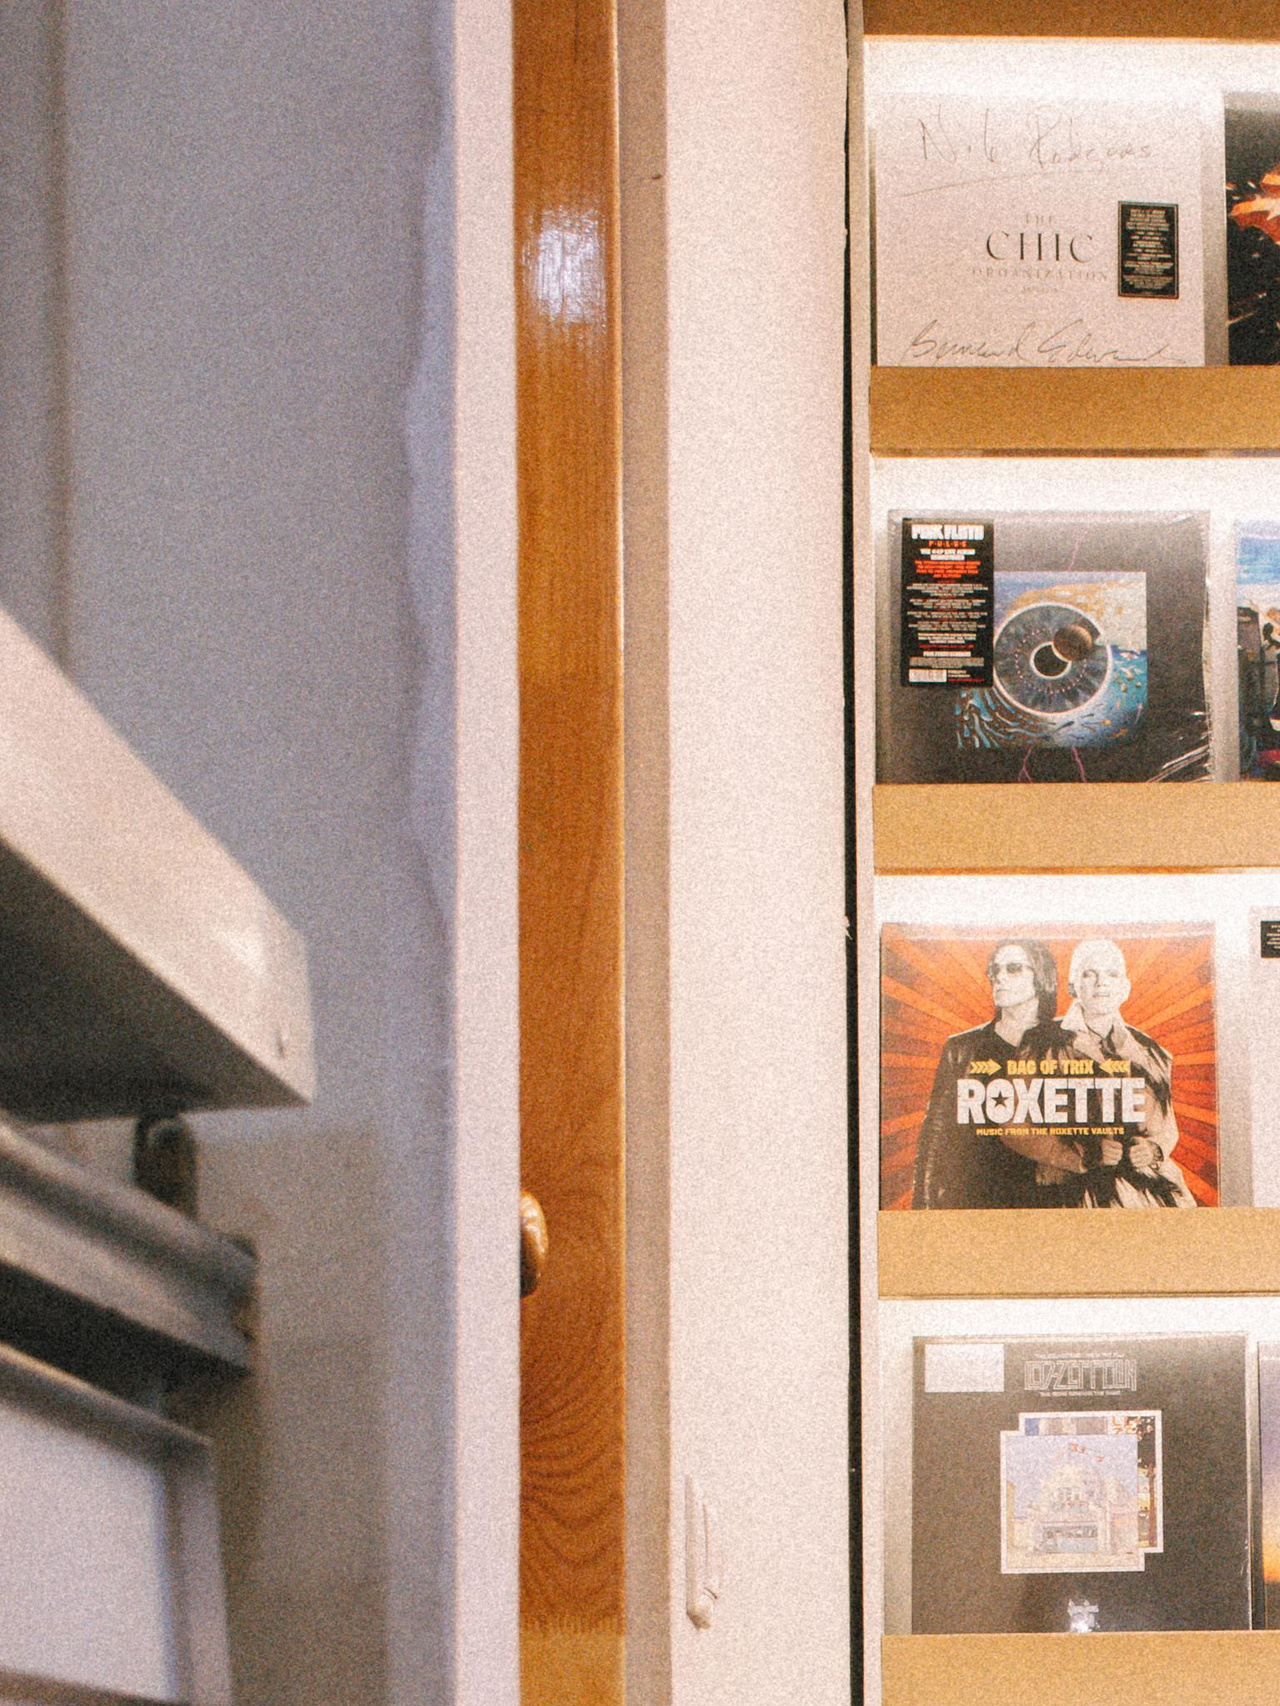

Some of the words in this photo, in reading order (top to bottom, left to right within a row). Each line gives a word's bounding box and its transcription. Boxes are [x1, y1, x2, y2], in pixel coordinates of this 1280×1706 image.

[986, 230, 1093, 263] CHIC
[1007, 1060, 1036, 1075] BAG
[1040, 1060, 1057, 1075] OF
[1061, 1059, 1094, 1075] TRIX
[957, 1078, 1145, 1124] ROXETTE
[976, 1128, 1003, 1136] MUSIC
[1005, 1127, 1029, 1135] FROM
[1031, 1127, 1048, 1135] THE
[1050, 1127, 1089, 1135] ROXETTE
[1091, 1127, 1124, 1135] VAULTS
